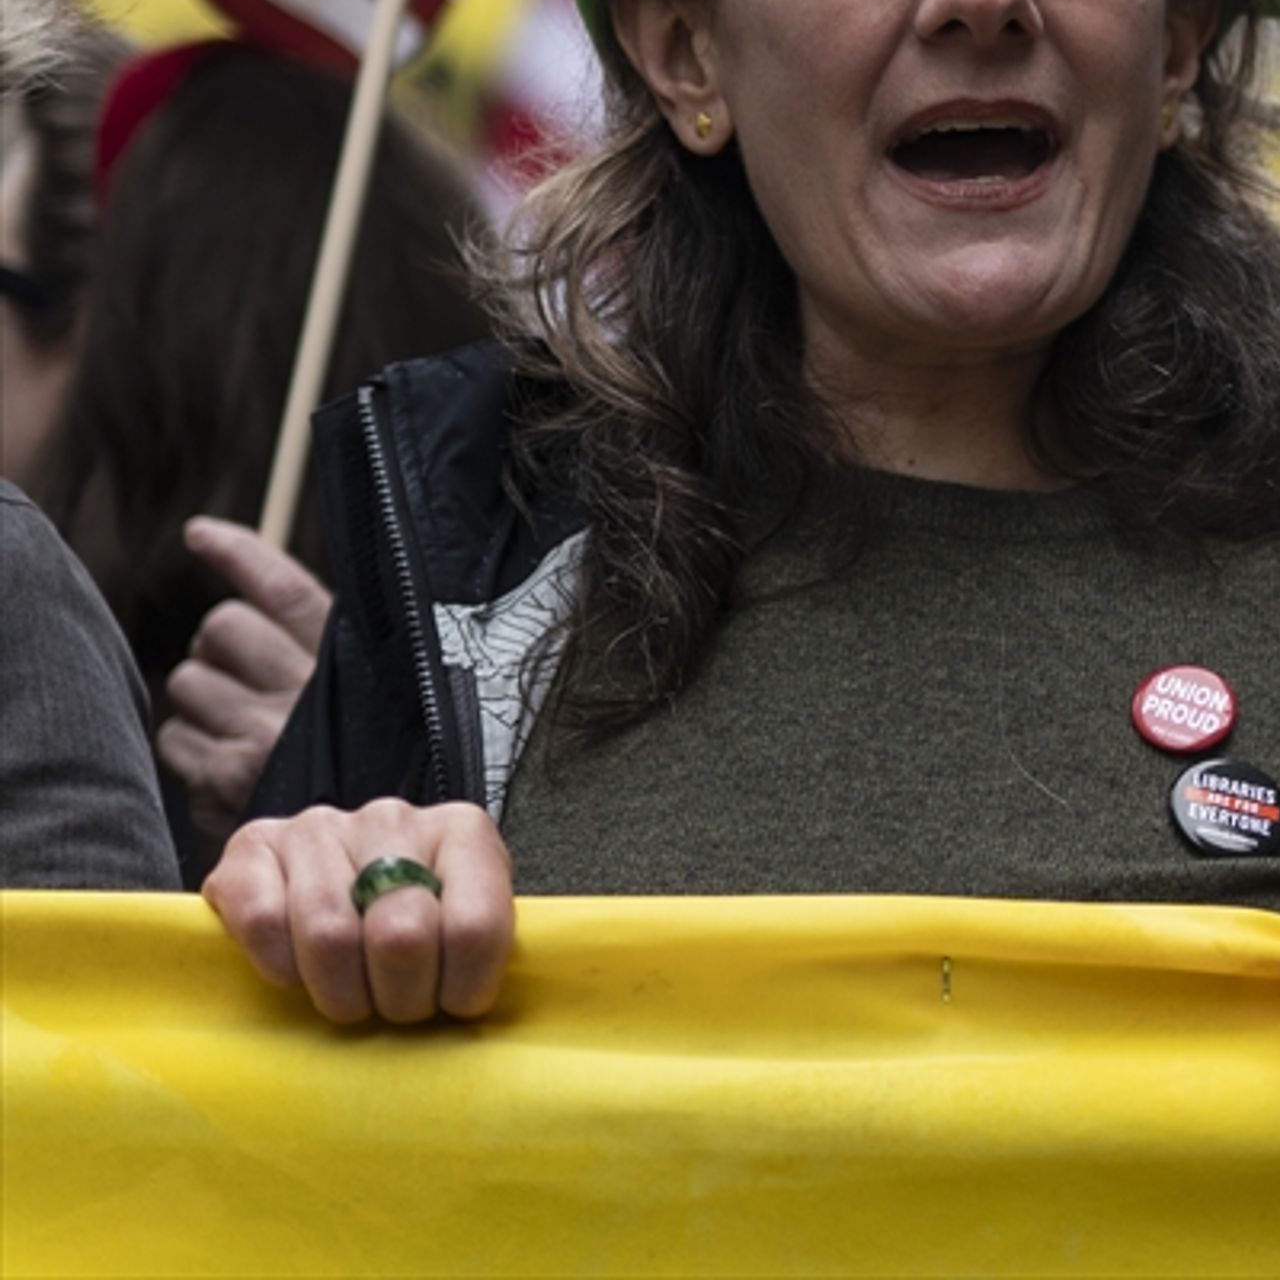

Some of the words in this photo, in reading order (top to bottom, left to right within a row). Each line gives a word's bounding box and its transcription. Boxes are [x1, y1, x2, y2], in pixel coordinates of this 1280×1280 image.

[1156, 673, 1230, 714] UNION
[1141, 693, 1220, 736] PROUD
[1192, 772, 1276, 805] LIBRARIES
[1188, 802, 1271, 836] EVERYONE
